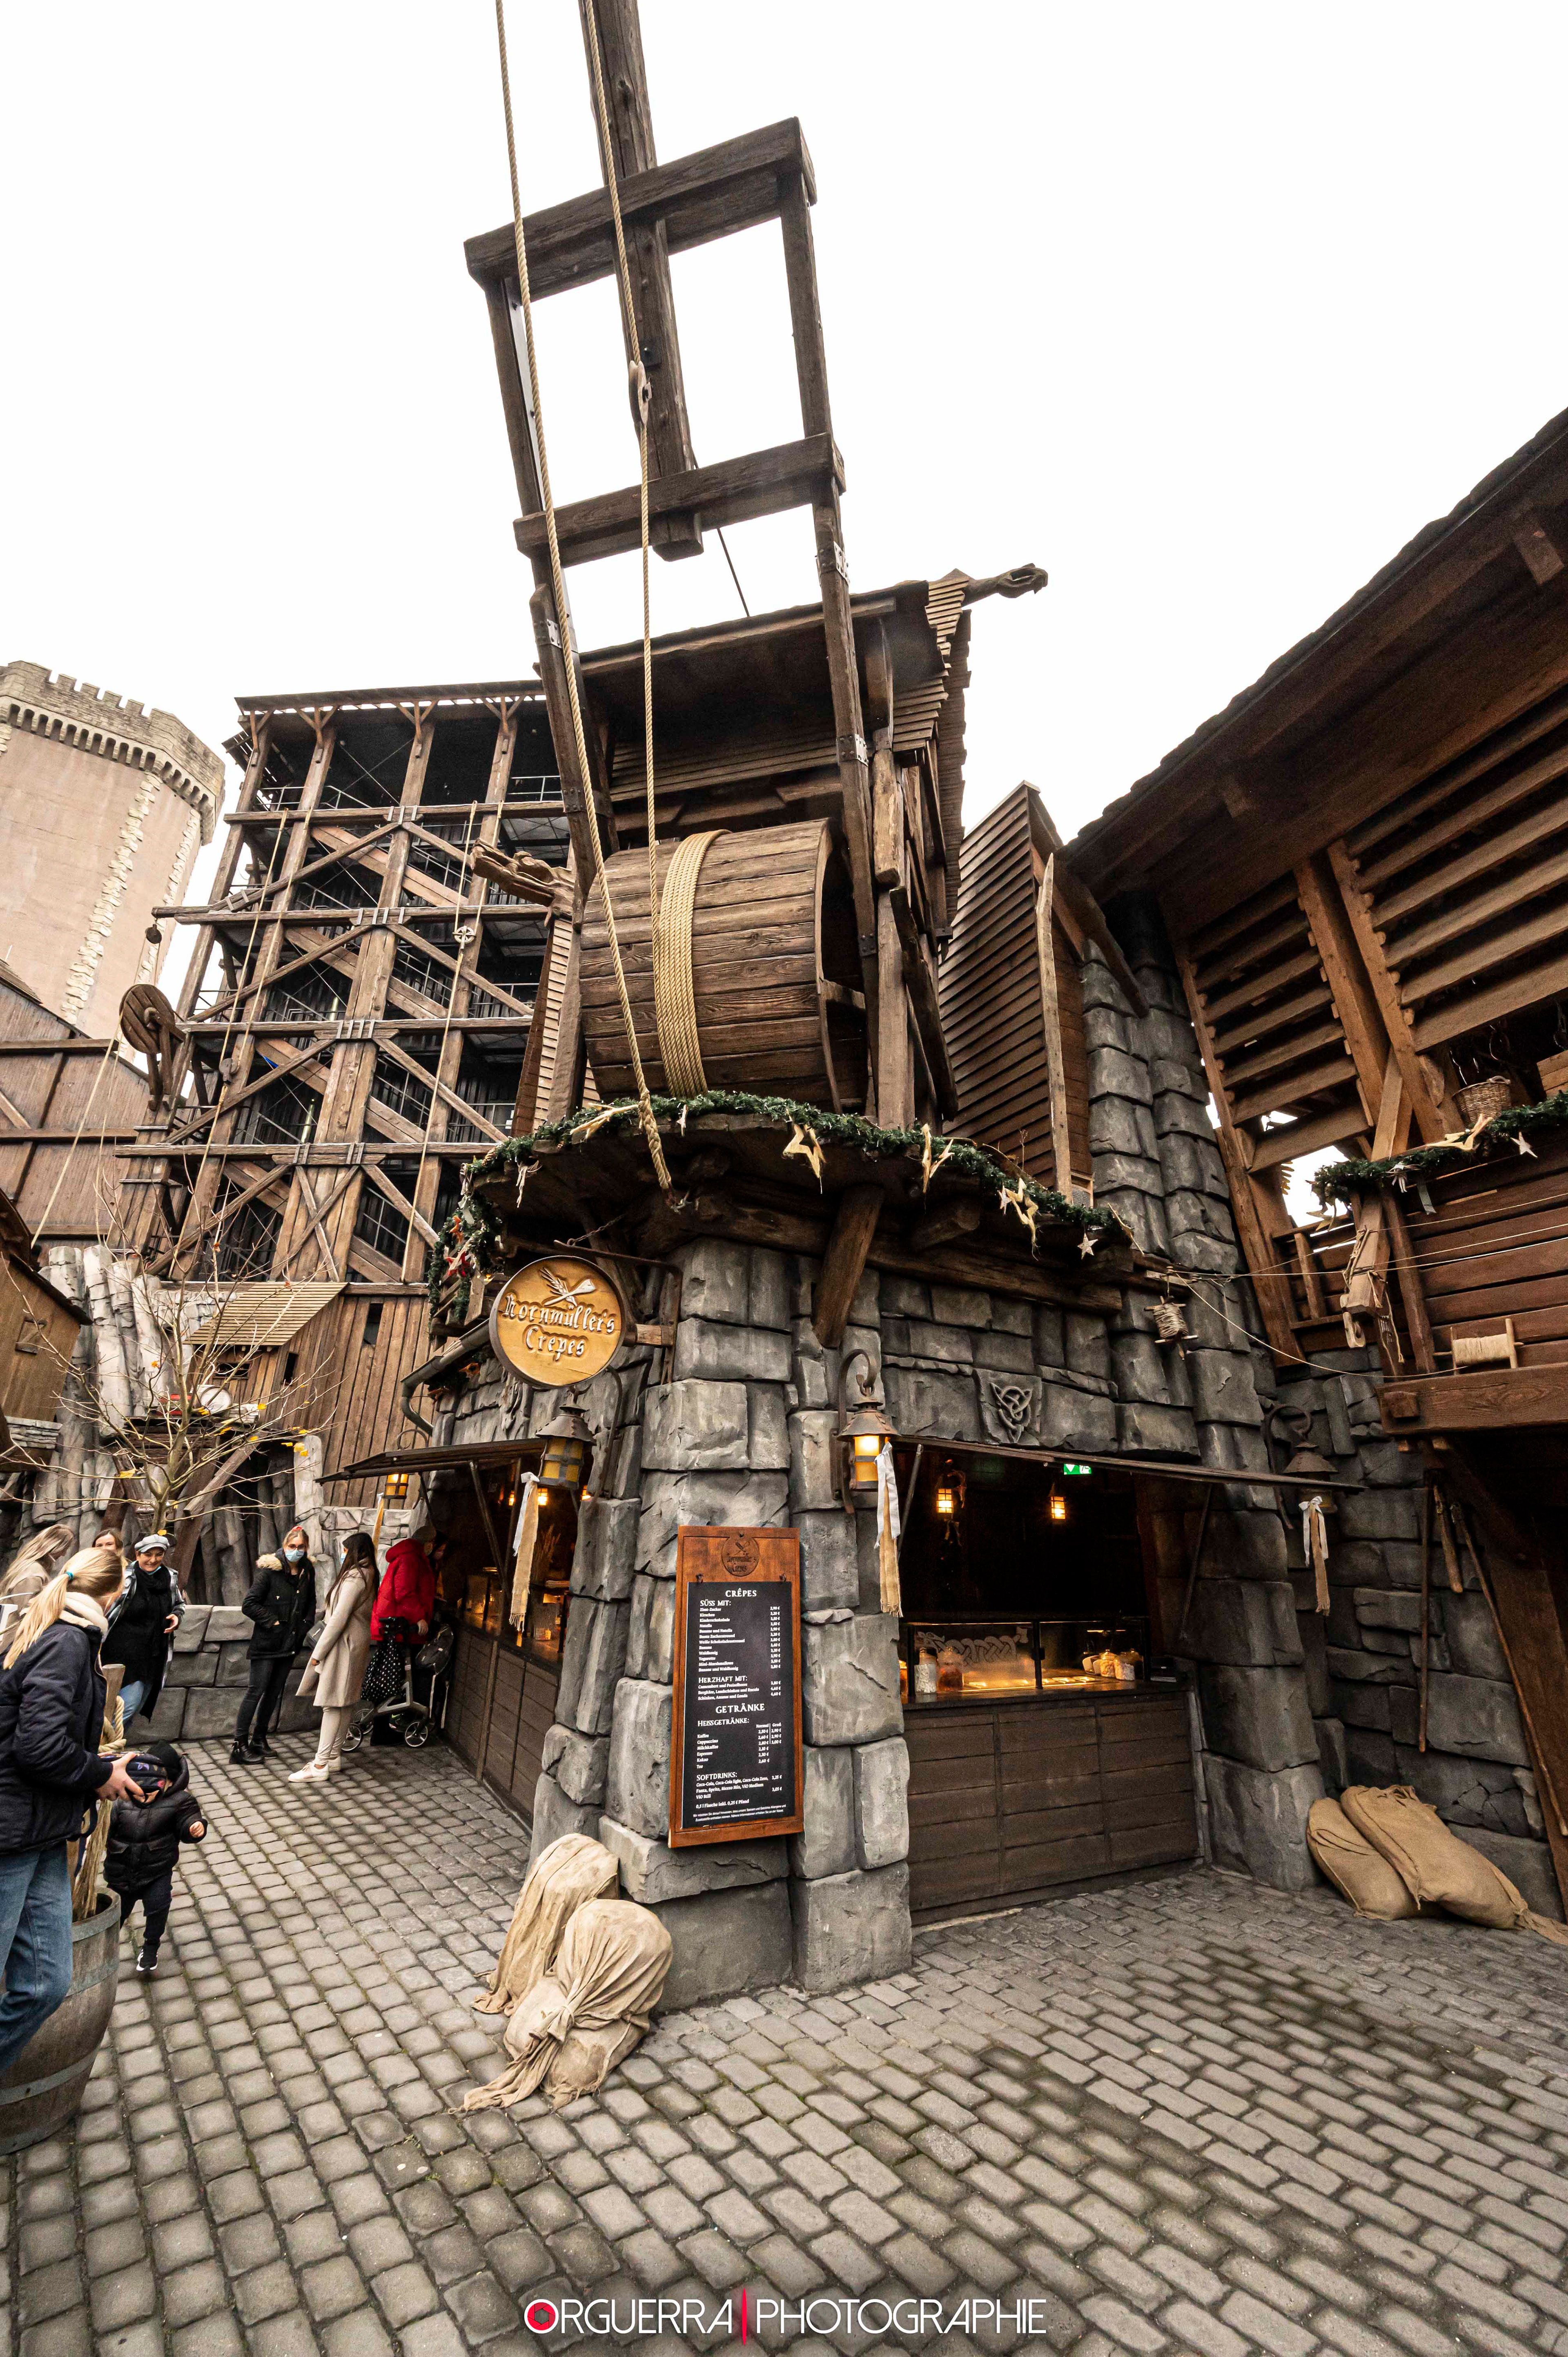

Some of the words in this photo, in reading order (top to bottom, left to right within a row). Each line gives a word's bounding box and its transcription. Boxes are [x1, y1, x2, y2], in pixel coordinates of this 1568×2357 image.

[526, 1327, 584, 1360] Crepes
[725, 1588, 757, 1597] CRÊPES
[716, 1703, 765, 1713] GETRÄNKE
[698, 1717, 749, 1726] HEISSGETRÄNKE:
[697, 1772, 737, 1781] SOFTDRINKS:
